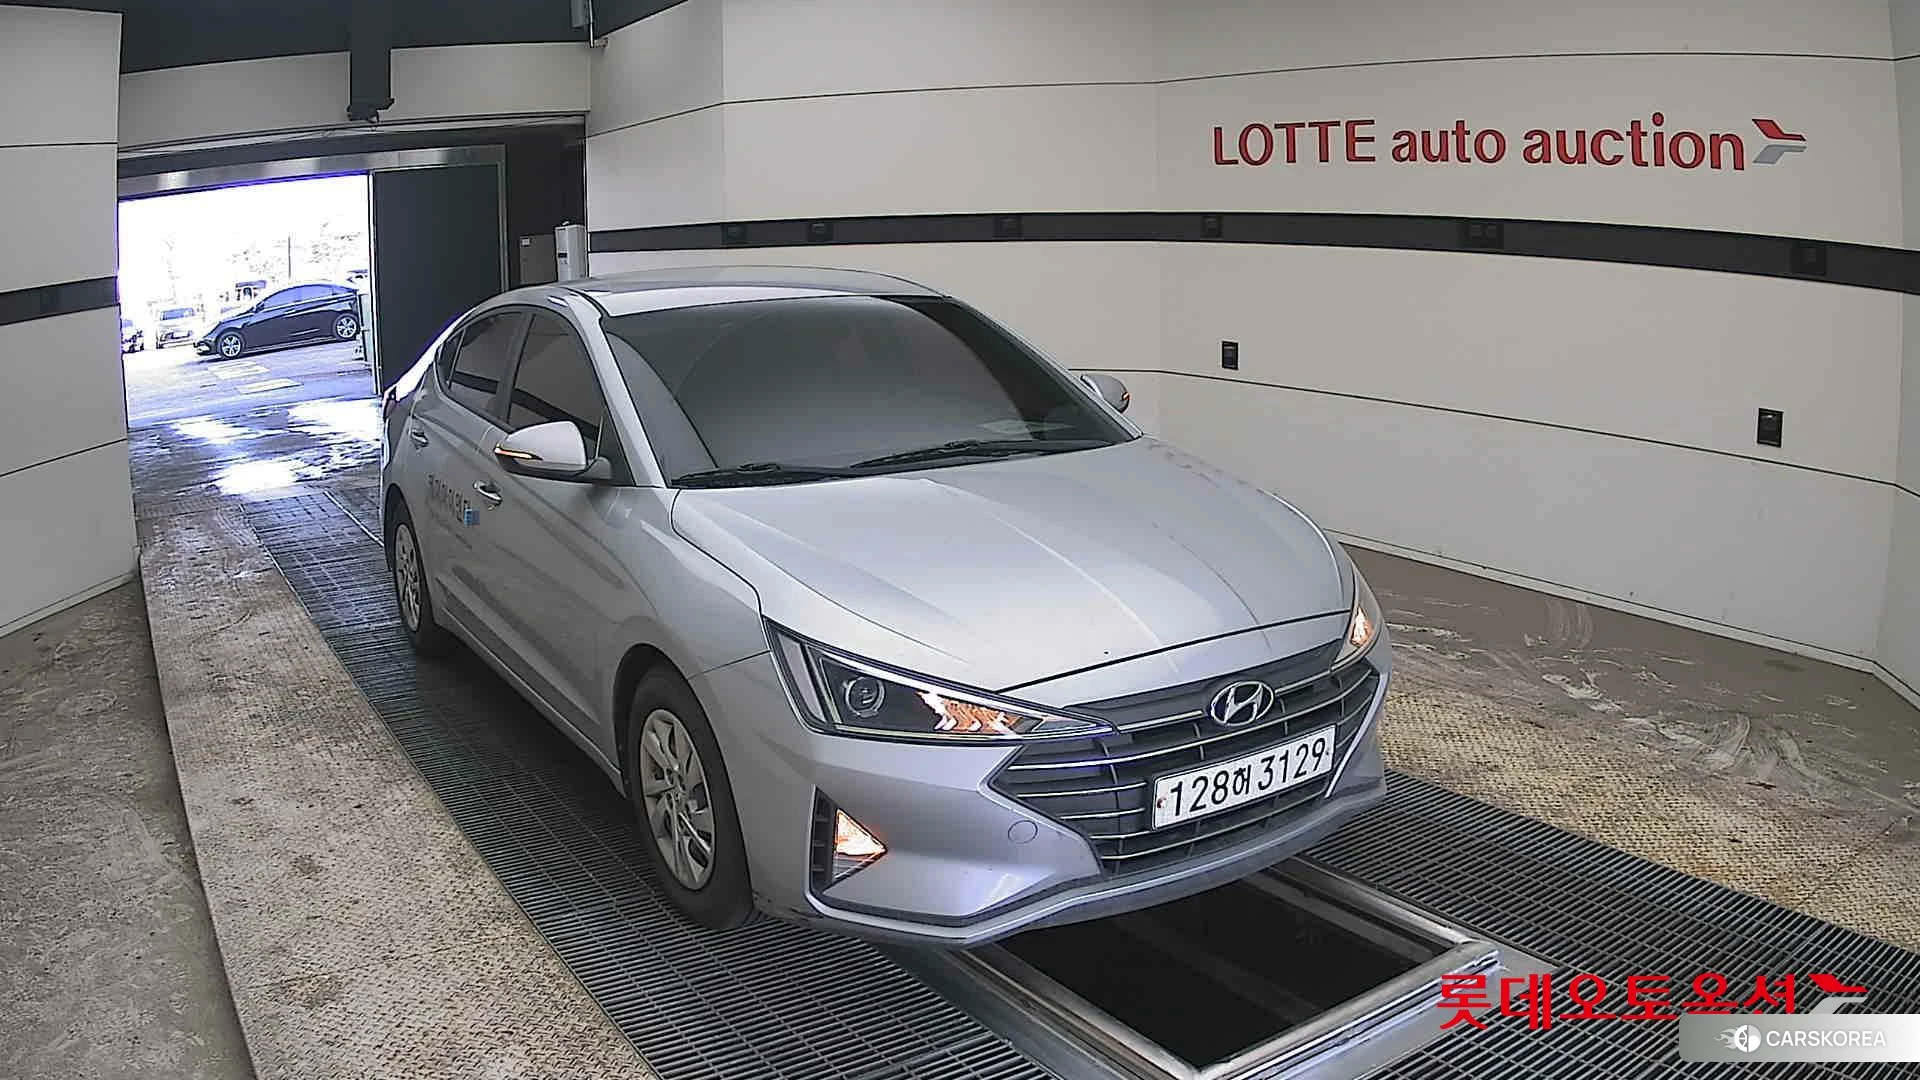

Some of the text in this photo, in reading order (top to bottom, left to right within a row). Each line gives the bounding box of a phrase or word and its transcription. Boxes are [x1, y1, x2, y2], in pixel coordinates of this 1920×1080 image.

[1213, 112, 1745, 171] LOTTE auto auction
